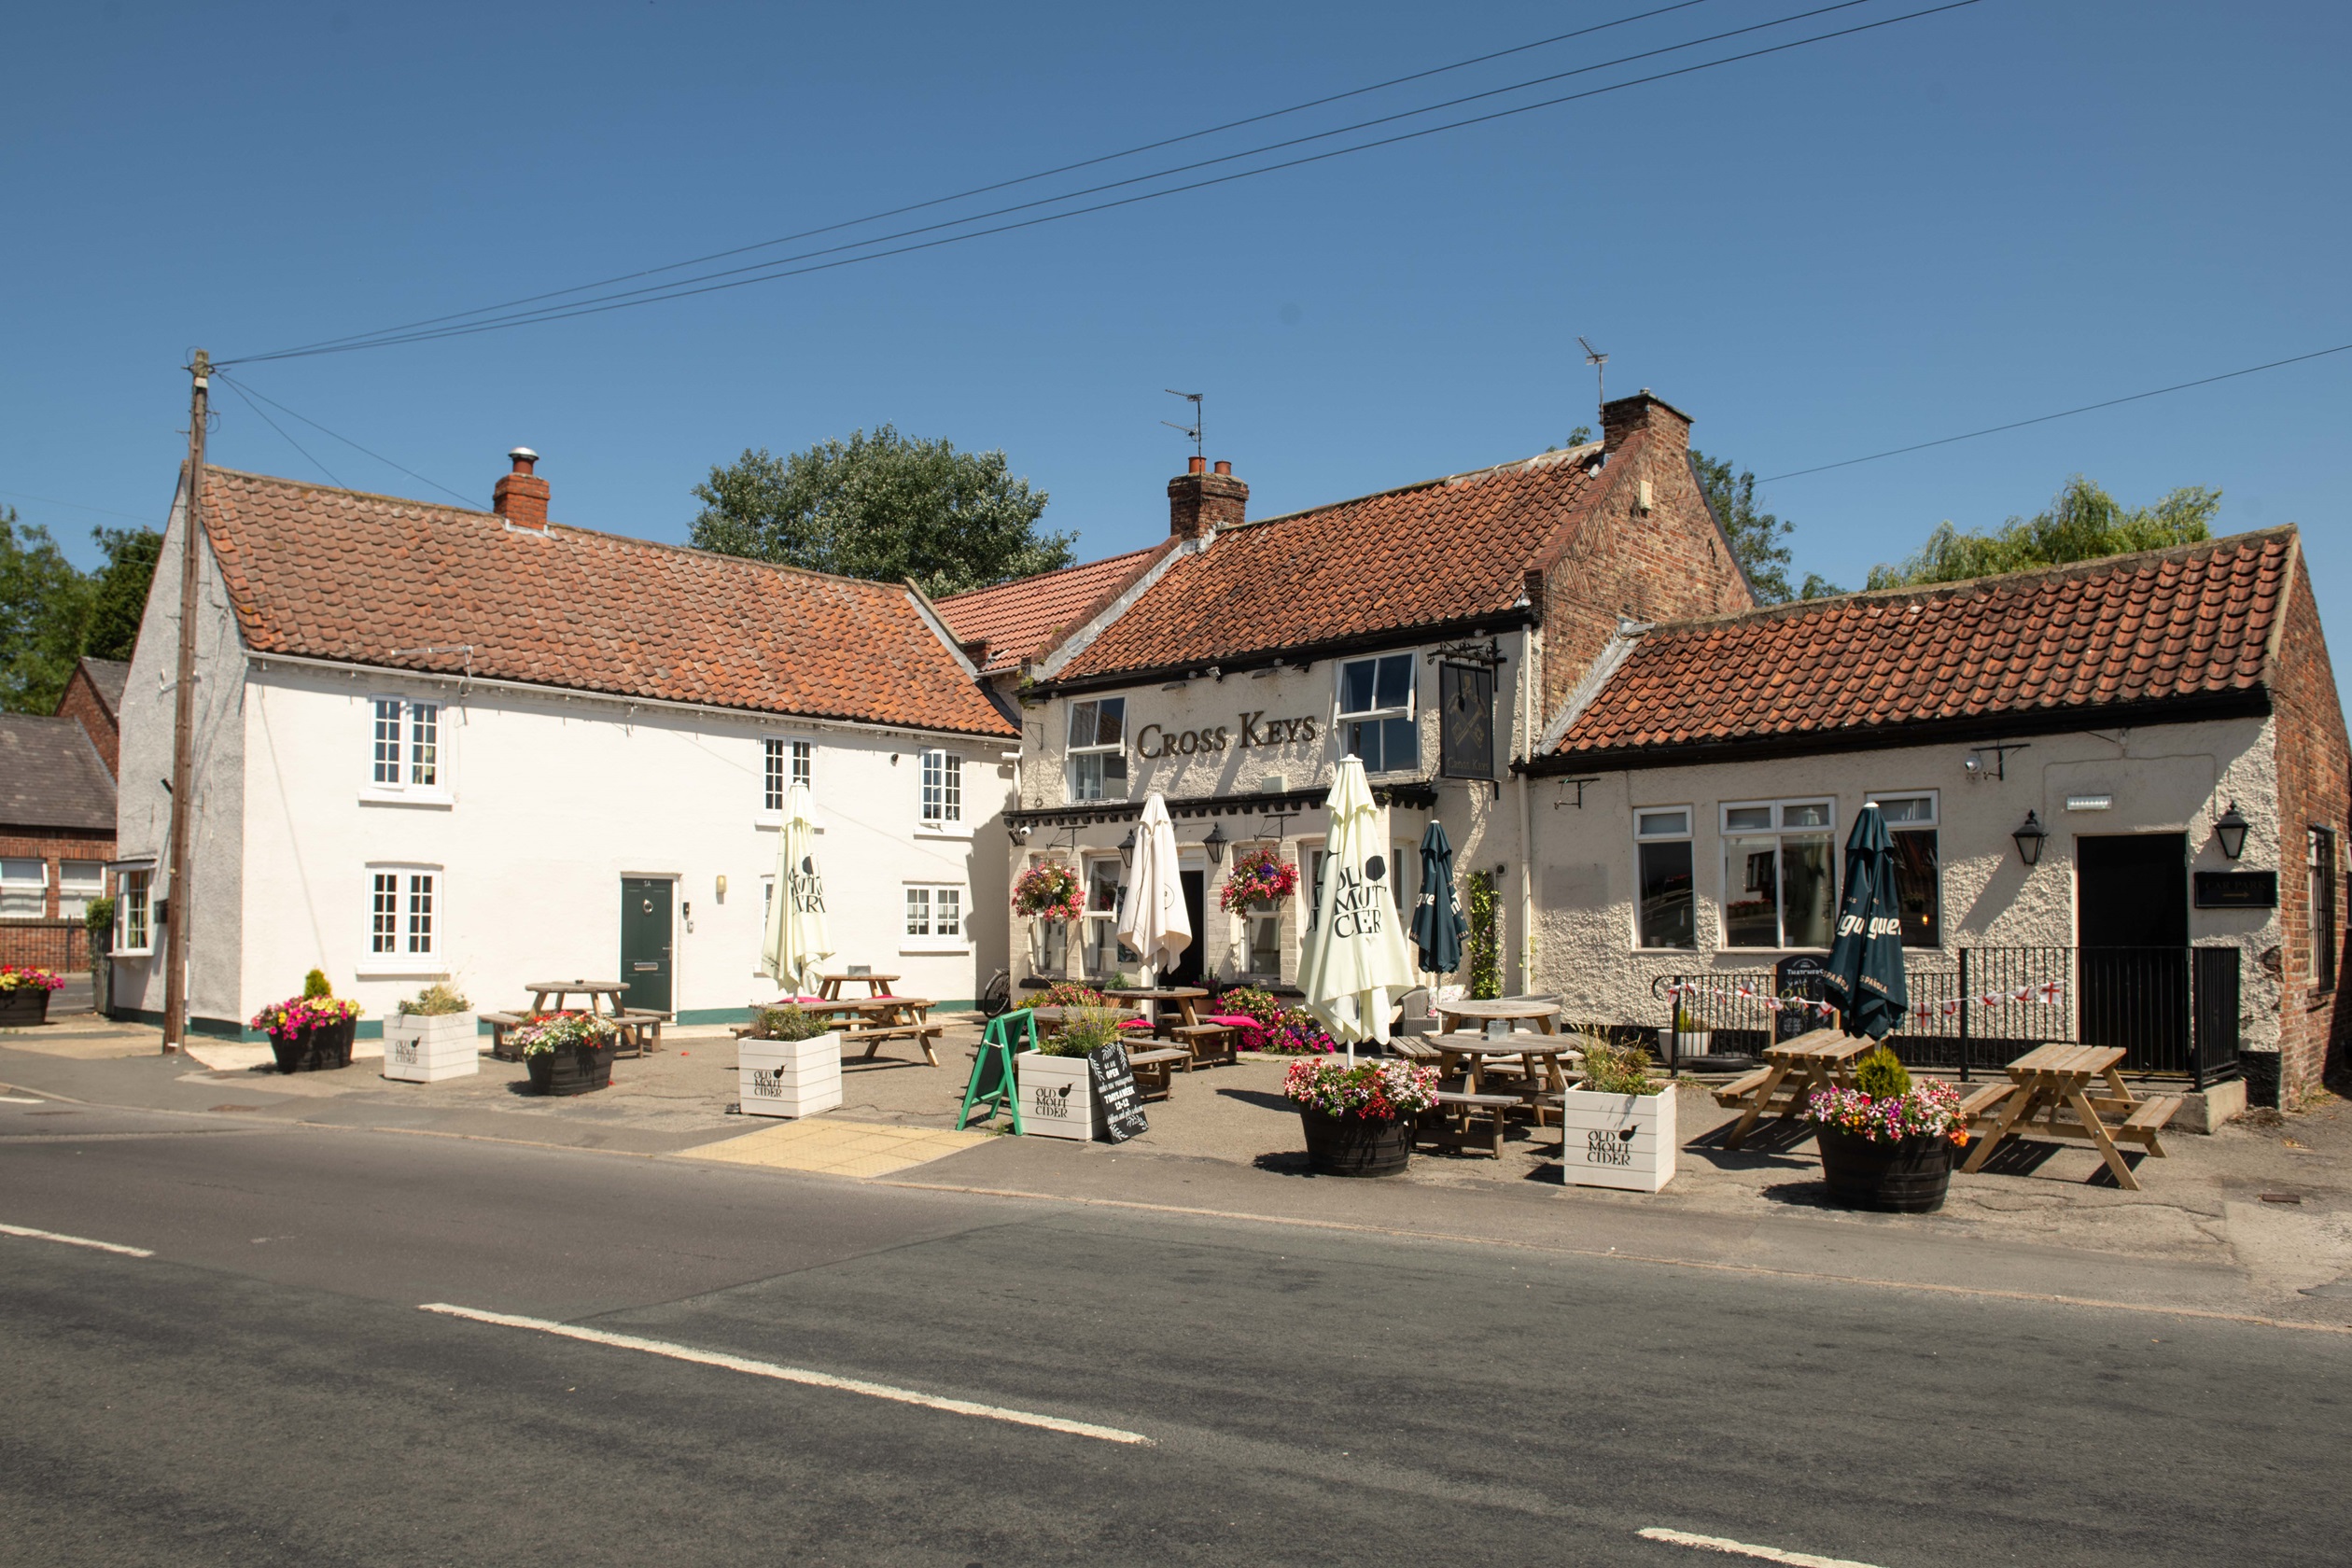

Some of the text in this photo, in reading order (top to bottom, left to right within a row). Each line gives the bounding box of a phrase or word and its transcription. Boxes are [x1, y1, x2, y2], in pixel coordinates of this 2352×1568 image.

[753, 1071, 772, 1080] OLD
[754, 1079, 783, 1089] MOUT
[753, 1087, 782, 1098] CIDER
[1035, 1087, 1057, 1098] OLD
[1036, 1097, 1070, 1109] MOUT
[1035, 1106, 1068, 1118] CIDER
[1588, 1130, 1616, 1141] OLD
[1588, 1141, 1633, 1155] MOUT
[1587, 1151, 1631, 1166] CIDER
